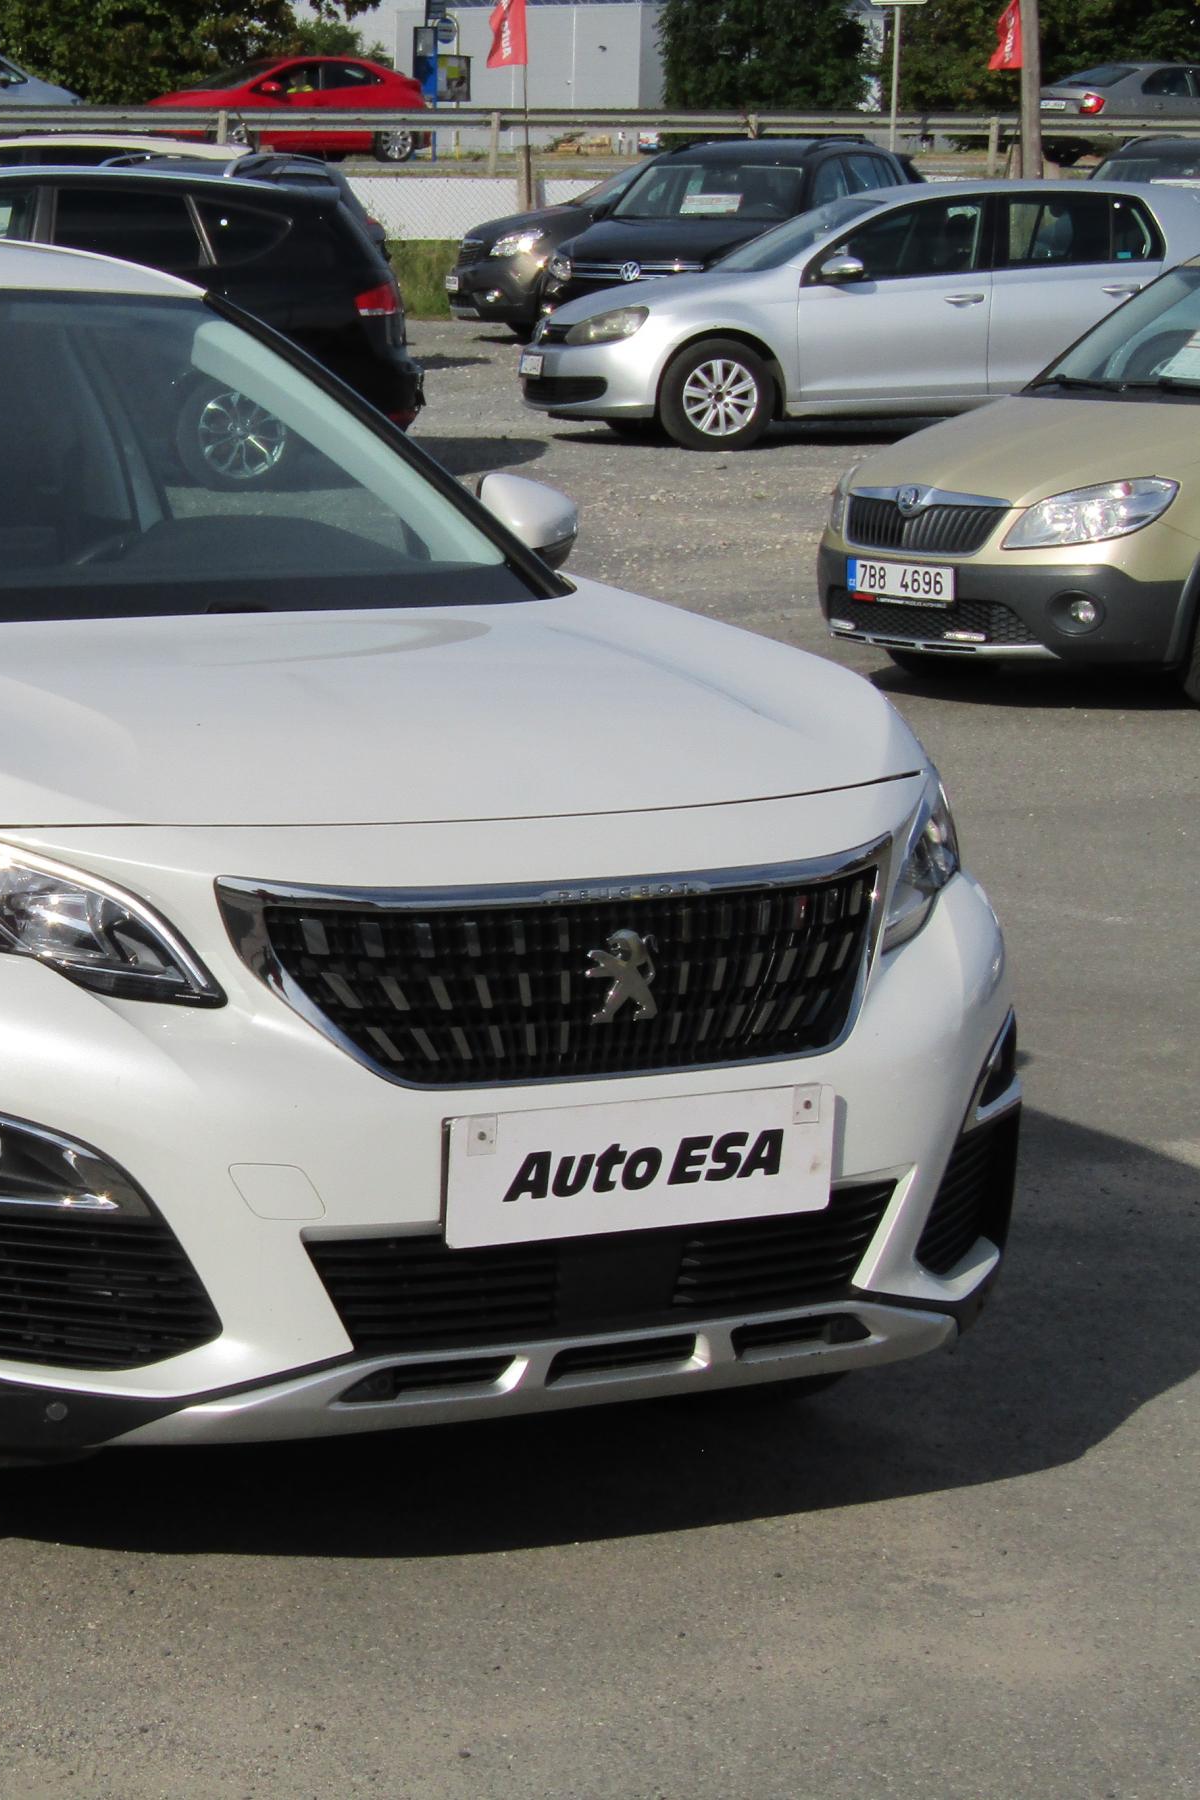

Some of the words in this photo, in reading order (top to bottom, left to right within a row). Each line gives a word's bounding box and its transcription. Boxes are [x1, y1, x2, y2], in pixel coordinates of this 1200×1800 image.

[859, 563, 886, 590] 7B8
[900, 568, 944, 596] 4696
[502, 1143, 663, 1202] Auto
[666, 1128, 785, 1186] ESA
